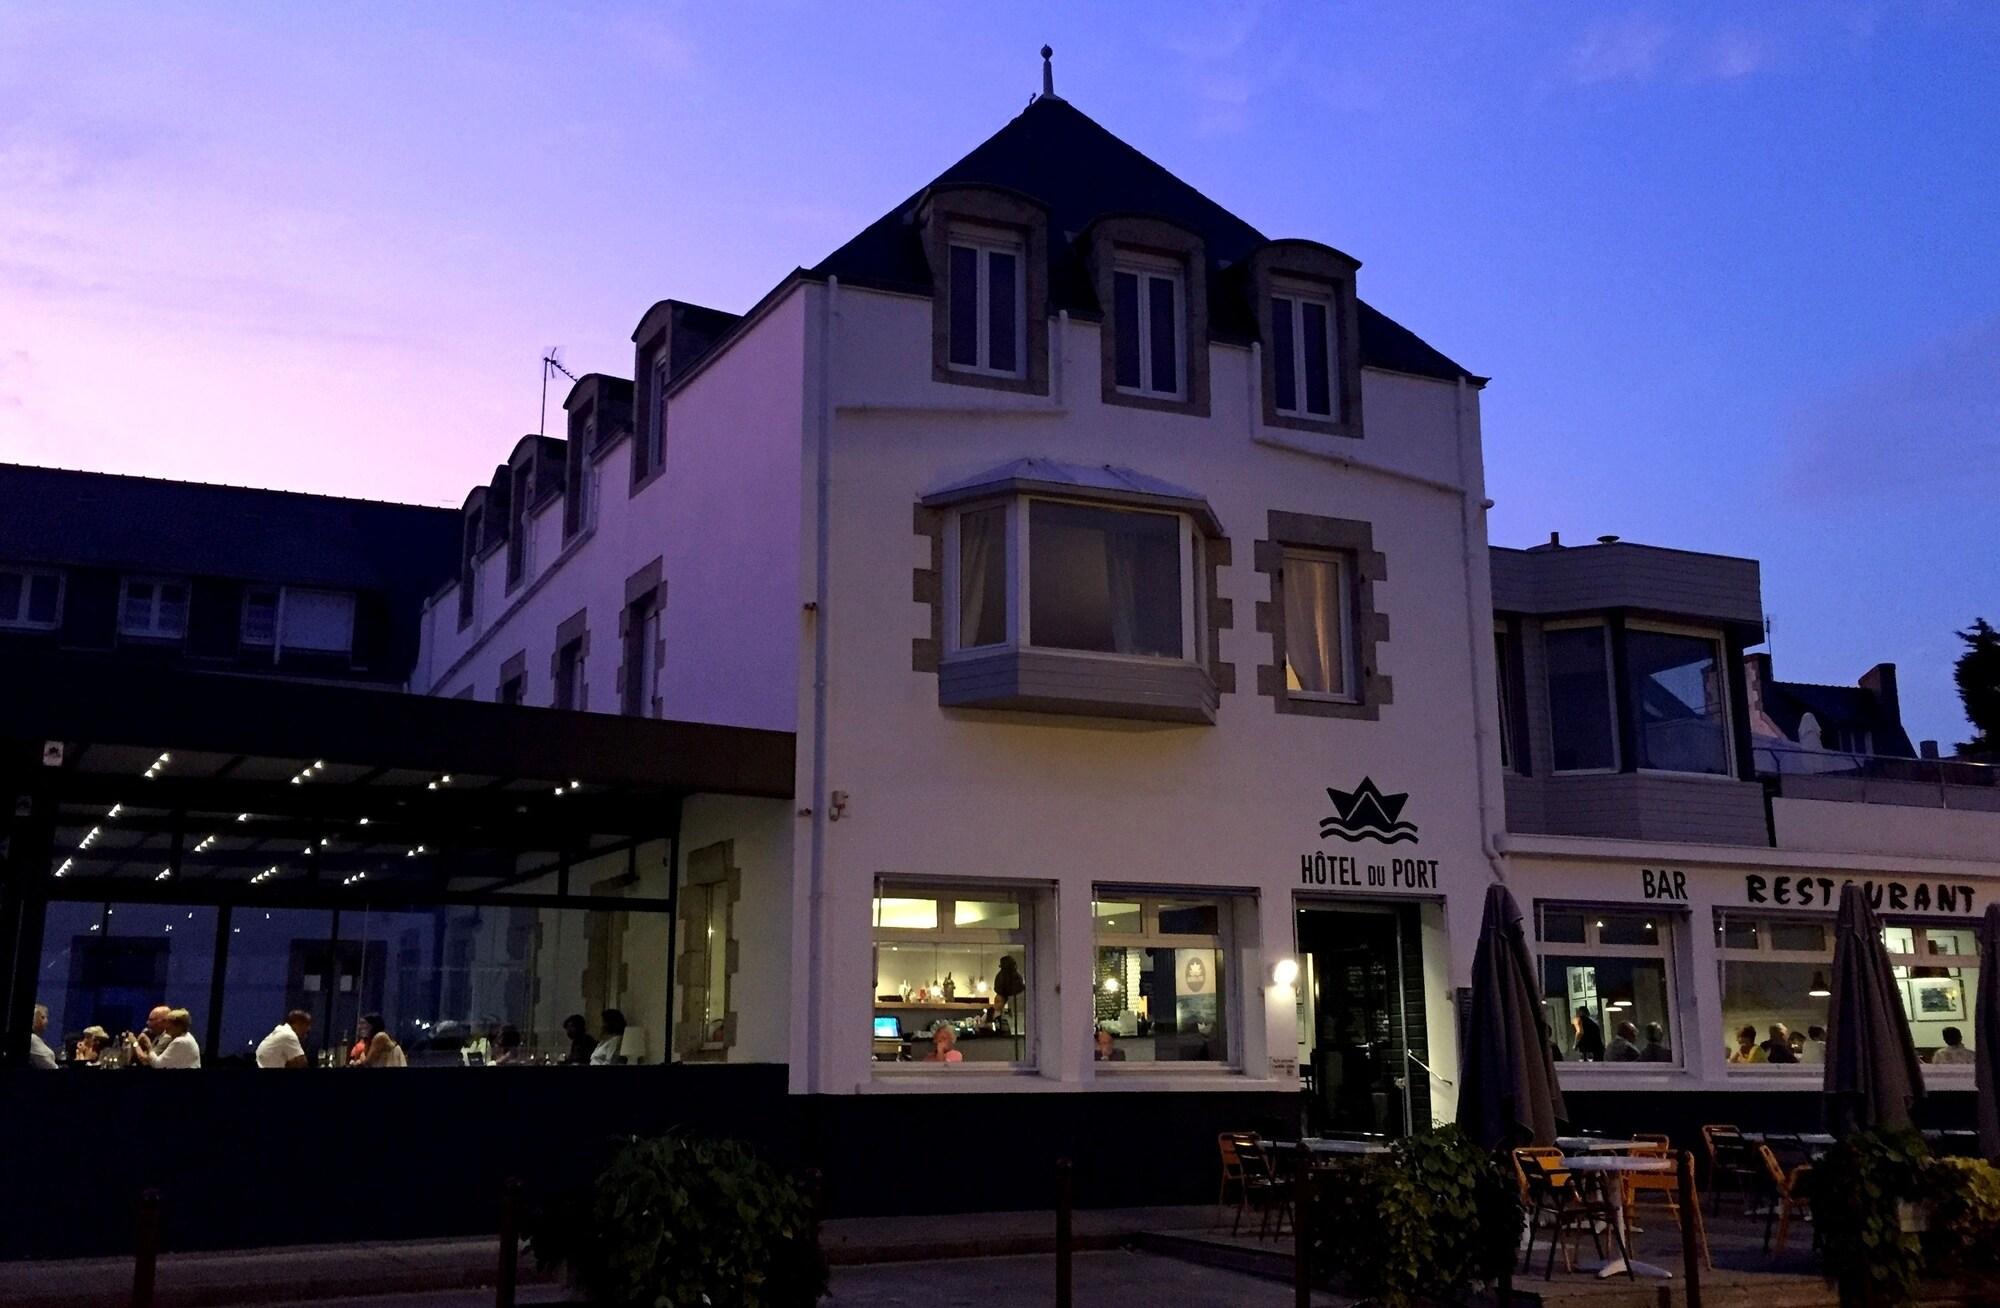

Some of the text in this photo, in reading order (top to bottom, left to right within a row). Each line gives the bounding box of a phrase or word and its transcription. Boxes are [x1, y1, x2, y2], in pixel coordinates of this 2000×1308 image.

[1301, 850, 1439, 888] HÔTEL DU PORT
[1642, 868, 1688, 900] BAR
[1746, 874, 1976, 913] RESTURANT
